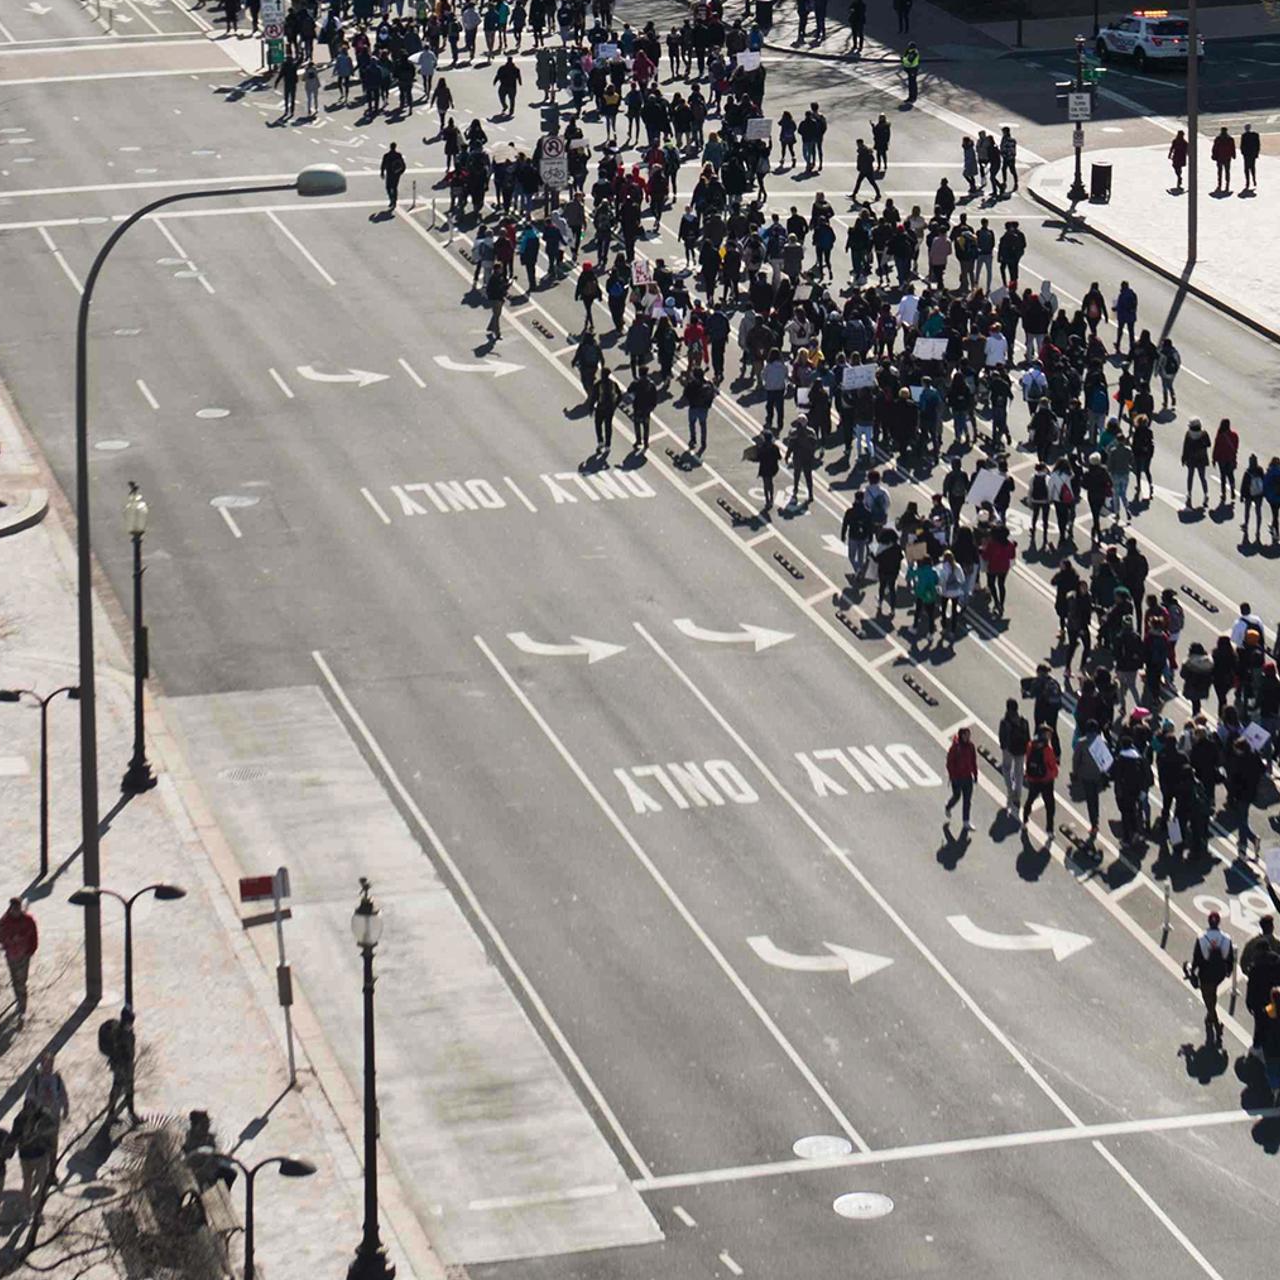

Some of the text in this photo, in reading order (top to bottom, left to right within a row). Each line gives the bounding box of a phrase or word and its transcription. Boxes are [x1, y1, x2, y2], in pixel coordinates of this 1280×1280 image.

[390, 478, 507, 515] ONLY
[540, 470, 657, 504] ONLY
[613, 759, 760, 813] ONLY
[794, 743, 943, 797] ONLY
